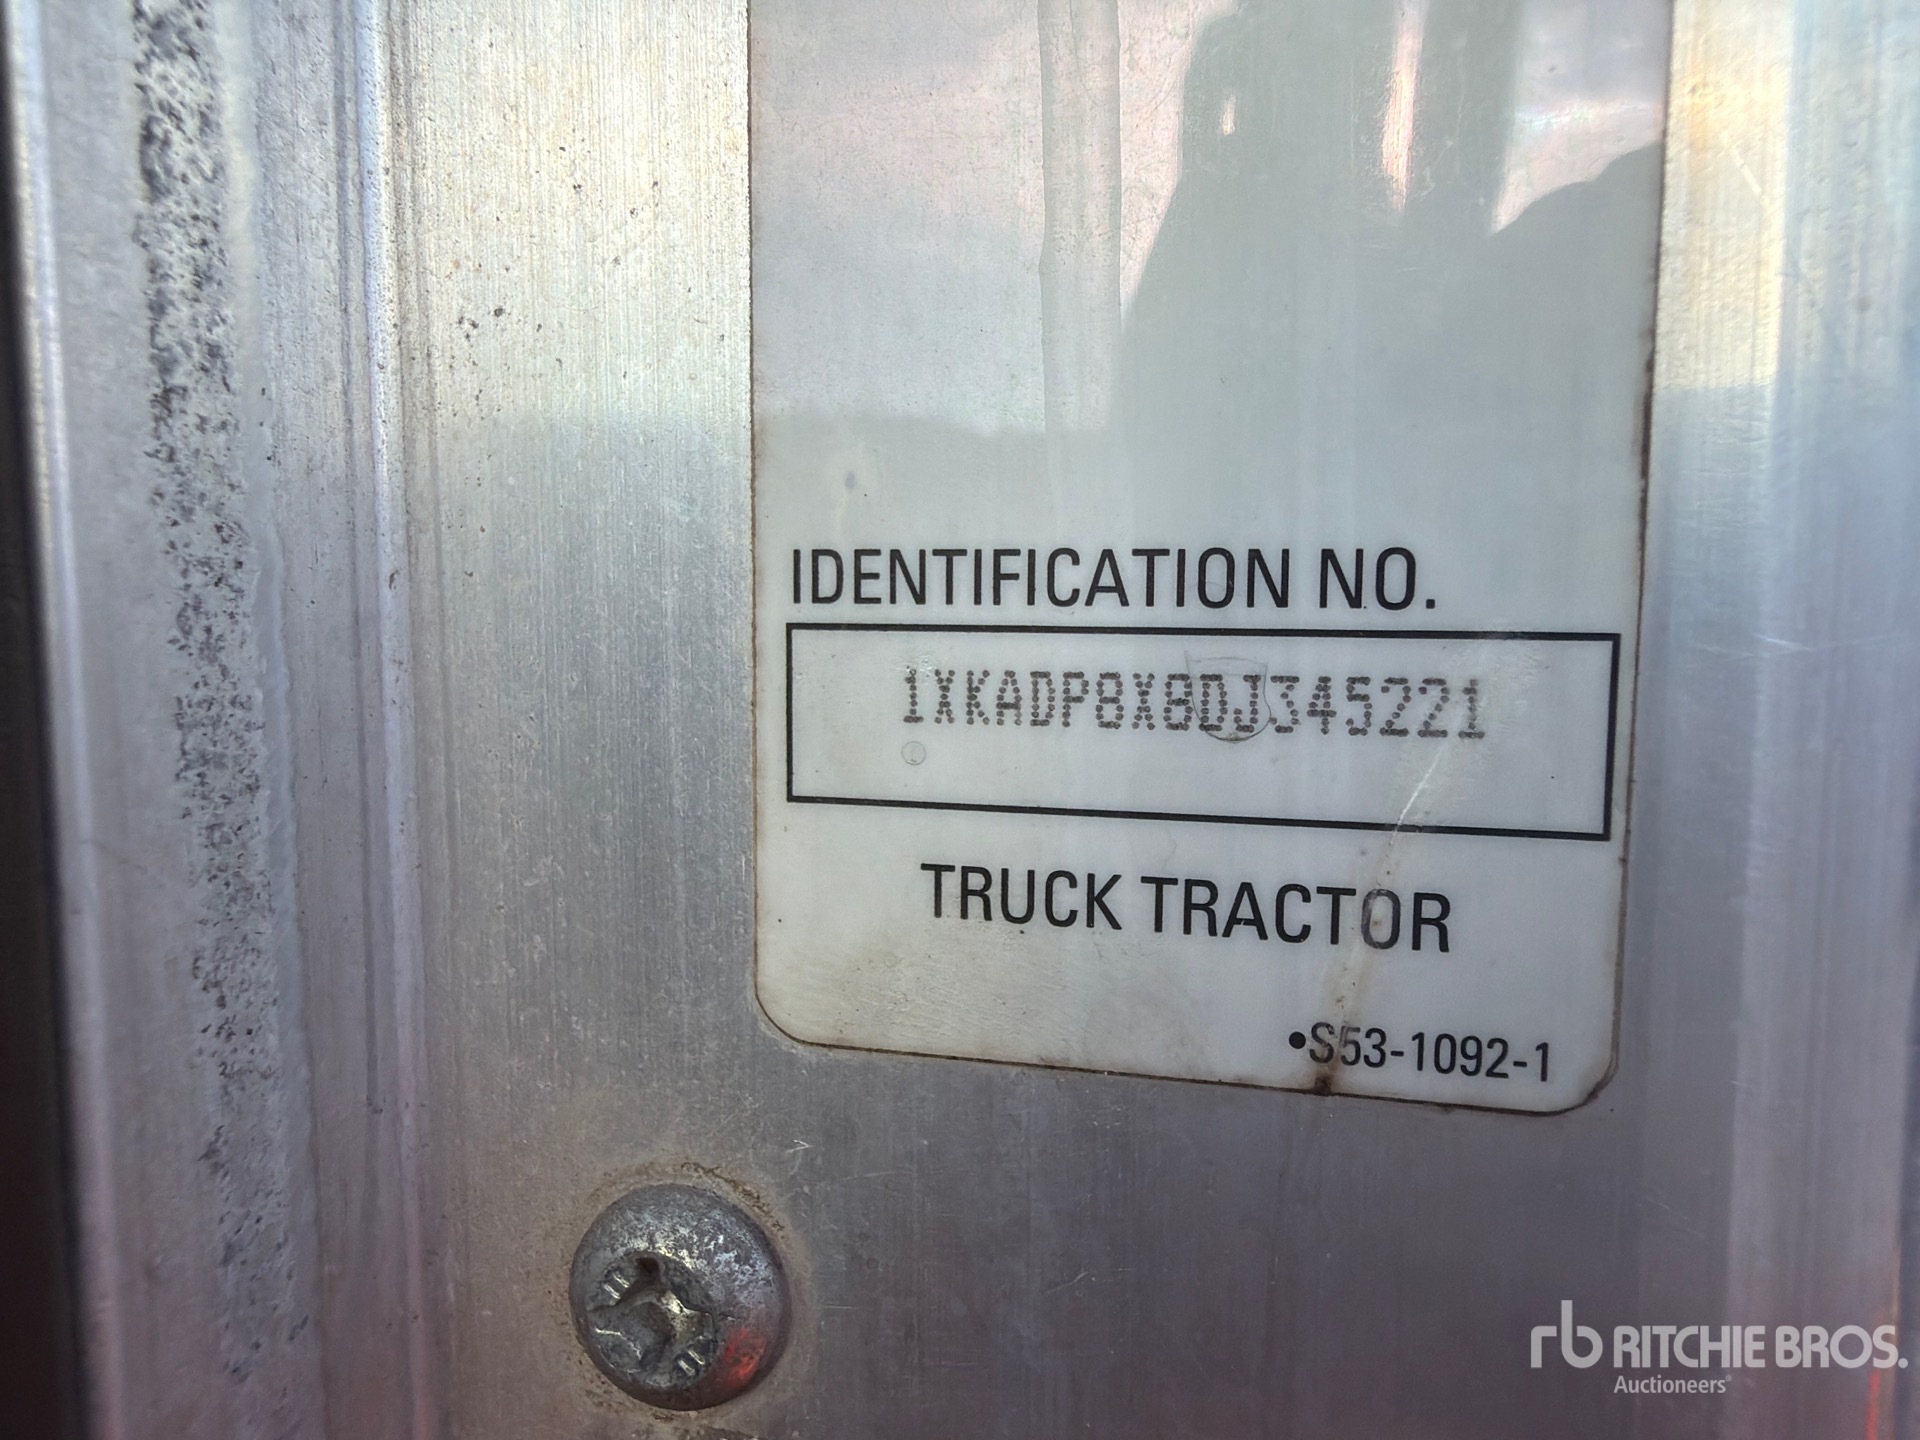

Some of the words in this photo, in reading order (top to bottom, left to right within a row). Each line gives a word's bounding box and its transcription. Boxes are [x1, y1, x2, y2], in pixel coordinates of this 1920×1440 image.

[792, 547, 1291, 610] IDENTIFICATION
[1319, 547, 1437, 611] NO.
[902, 667, 1486, 740] 1XKADP8X8DJ345221
[920, 863, 1123, 931] TRUCK
[1140, 875, 1452, 954] TRACTOR
